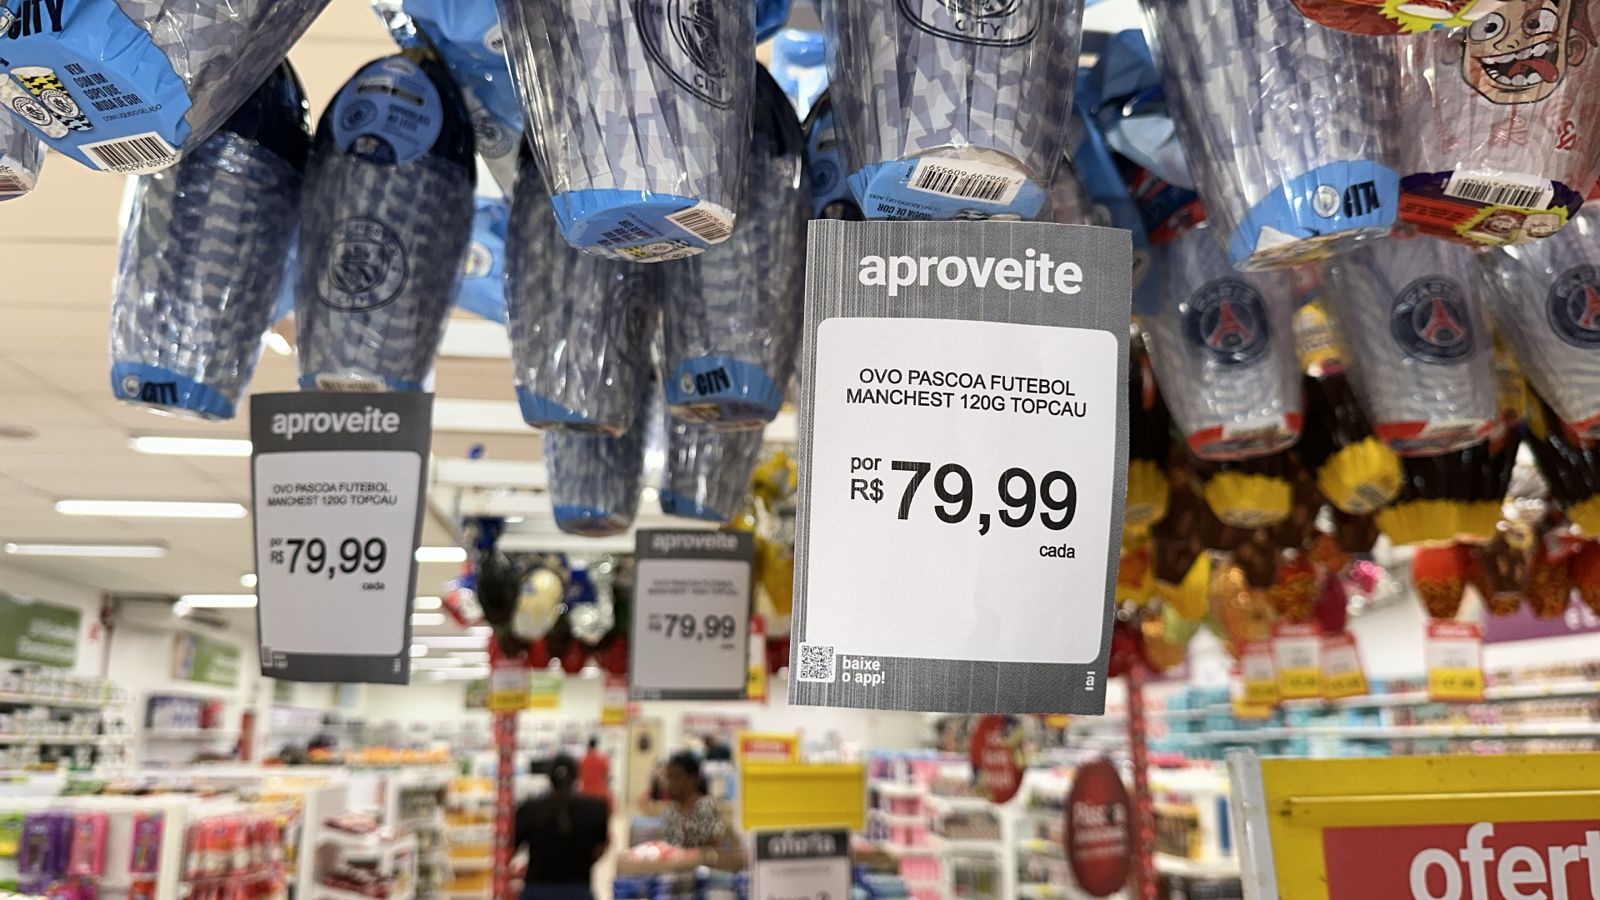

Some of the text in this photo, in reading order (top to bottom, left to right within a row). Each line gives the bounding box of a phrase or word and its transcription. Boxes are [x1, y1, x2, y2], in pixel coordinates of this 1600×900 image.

[8, 0, 63, 39] CITY
[955, 20, 1001, 36] CITY
[63, 63, 86, 75] VEM
[73, 72, 109, 88] COM UM
[83, 84, 122, 101] COPO QUE
[92, 99, 119, 112] MUDA
[116, 97, 129, 108] DE
[125, 93, 144, 106] COR
[928, 163, 967, 178] 609559
[969, 169, 1010, 182] 896299
[877, 203, 896, 213] COR
[858, 248, 1083, 296] aproveite
[859, 368, 1076, 397] OVO PASCOA FUTEBOL
[846, 388, 1087, 417] MANCHEST 120G TOPCAU
[271, 406, 400, 440] aproveite
[850, 455, 882, 473] por
[273, 482, 390, 494] OVO PASCOA FUTEBOL
[267, 494, 397, 507] MANCHEST 120G TOPCAU
[850, 460, 1077, 536] R$ 79,99
[652, 532, 739, 553] aproveite
[1039, 543, 1076, 558] cada
[286, 536, 387, 580] 79,99
[664, 613, 737, 642] 79,99
[842, 656, 880, 670] baixe
[842, 671, 886, 686] o app!
